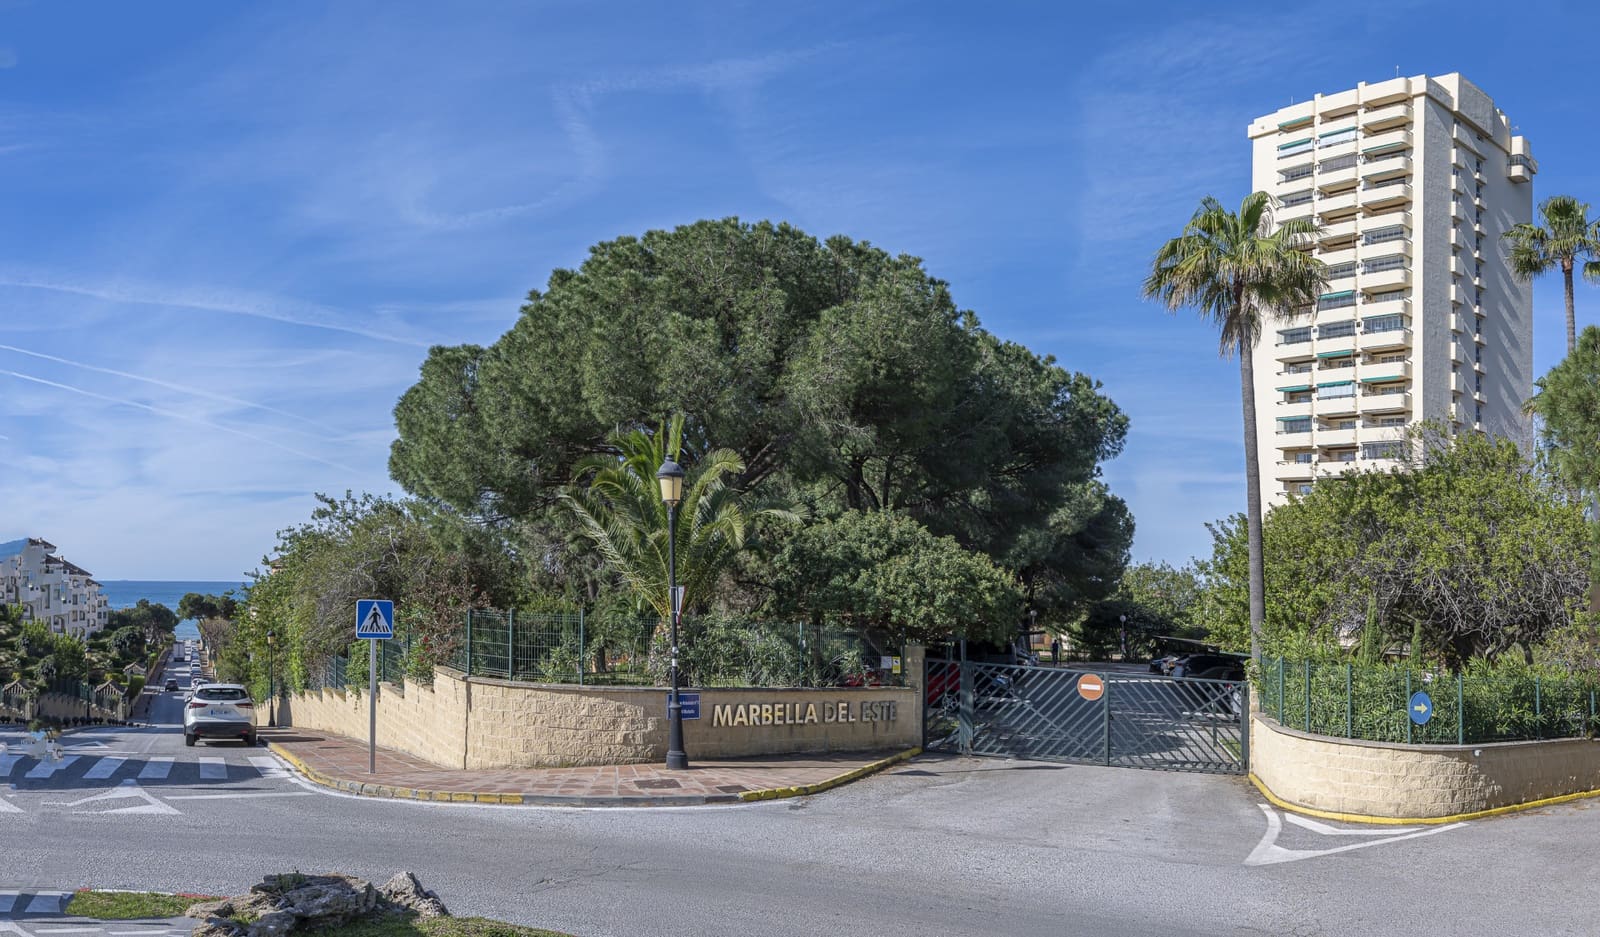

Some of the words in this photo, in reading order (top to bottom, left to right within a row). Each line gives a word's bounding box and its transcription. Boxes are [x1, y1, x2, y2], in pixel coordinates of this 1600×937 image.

[713, 703, 818, 727] MARBELLA
[824, 702, 856, 723] DEL
[861, 701, 897, 721] ESTE
